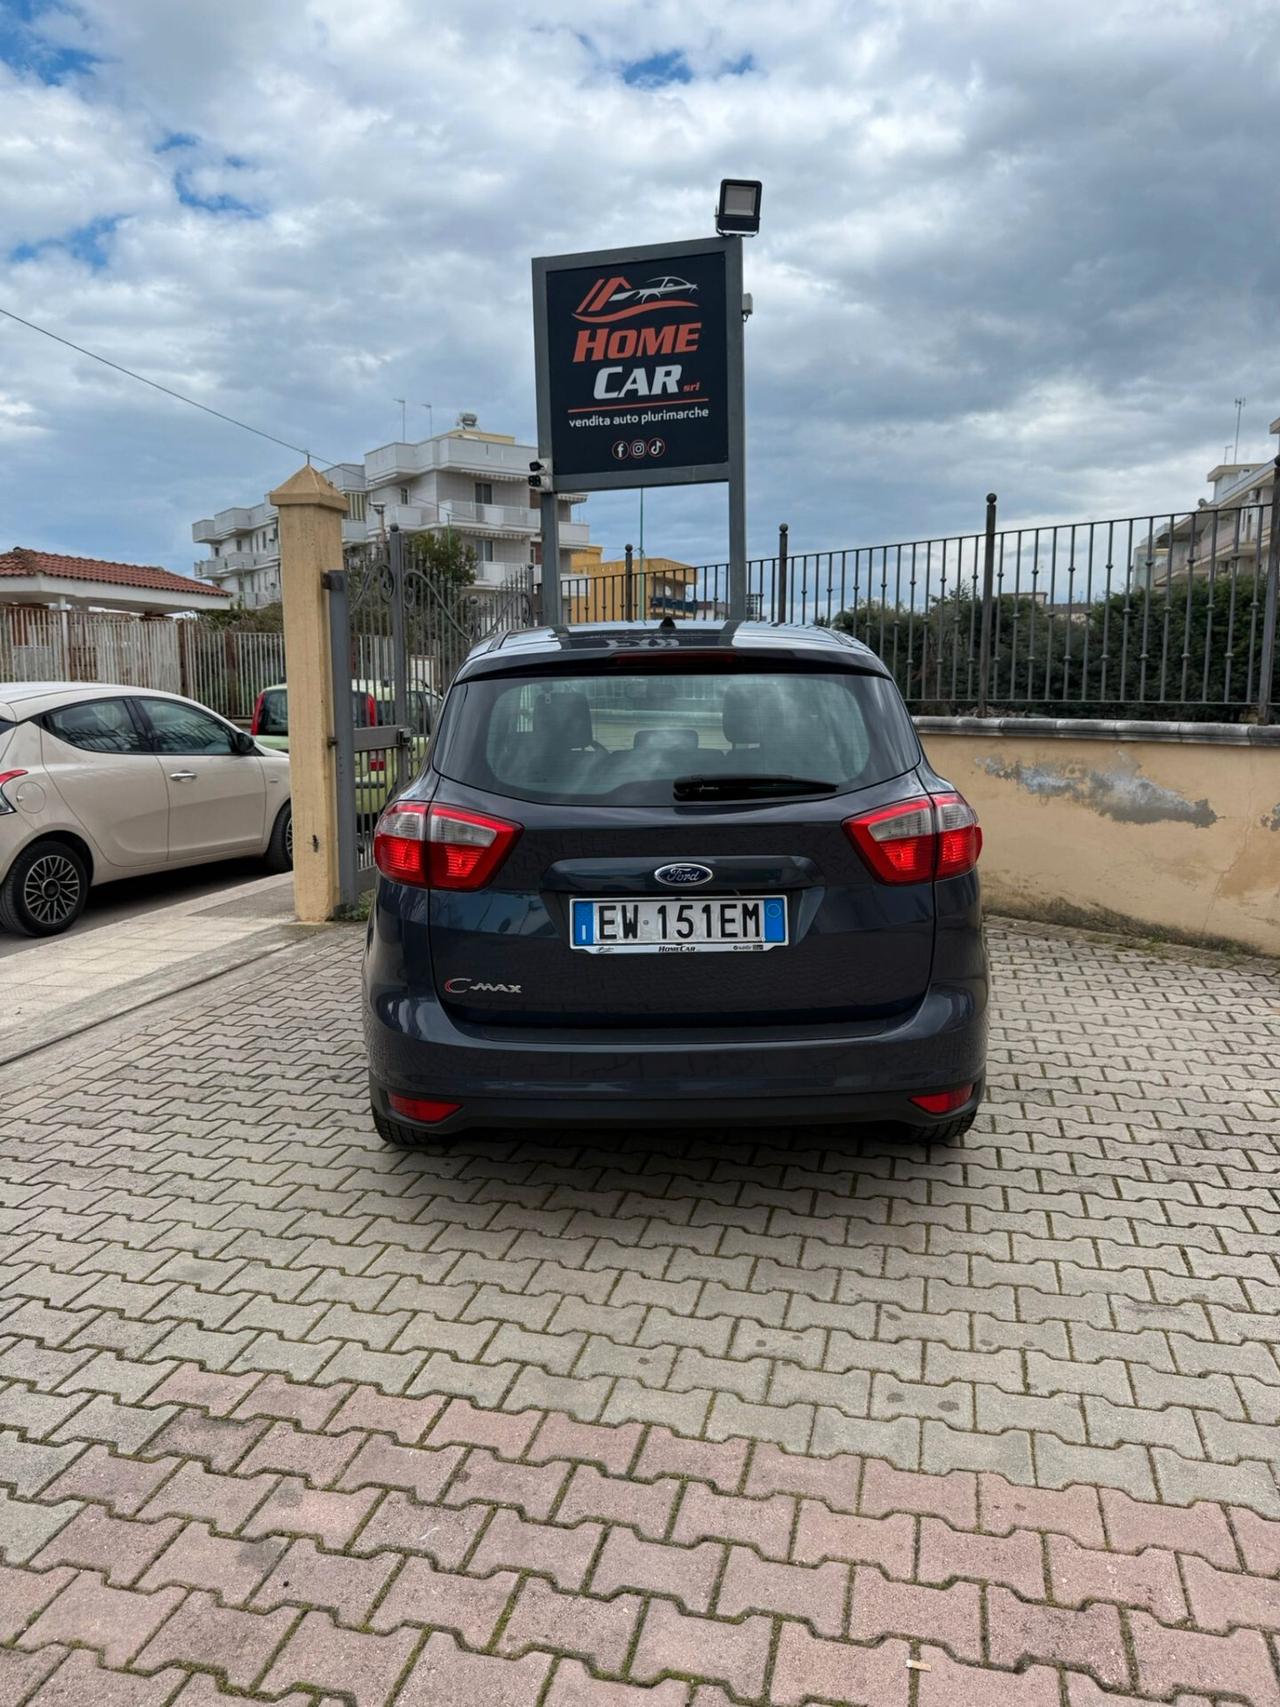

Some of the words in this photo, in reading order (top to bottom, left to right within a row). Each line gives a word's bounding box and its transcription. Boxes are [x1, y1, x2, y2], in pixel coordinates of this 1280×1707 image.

[573, 322, 701, 362] HOME
[593, 364, 682, 400] CAR
[683, 381, 700, 392] srl
[569, 415, 611, 427] vendita
[613, 414, 639, 425] auto
[641, 406, 709, 425] plurimarche
[667, 867, 700, 881] Ford
[599, 904, 639, 940] EW
[657, 903, 760, 939] 151EM
